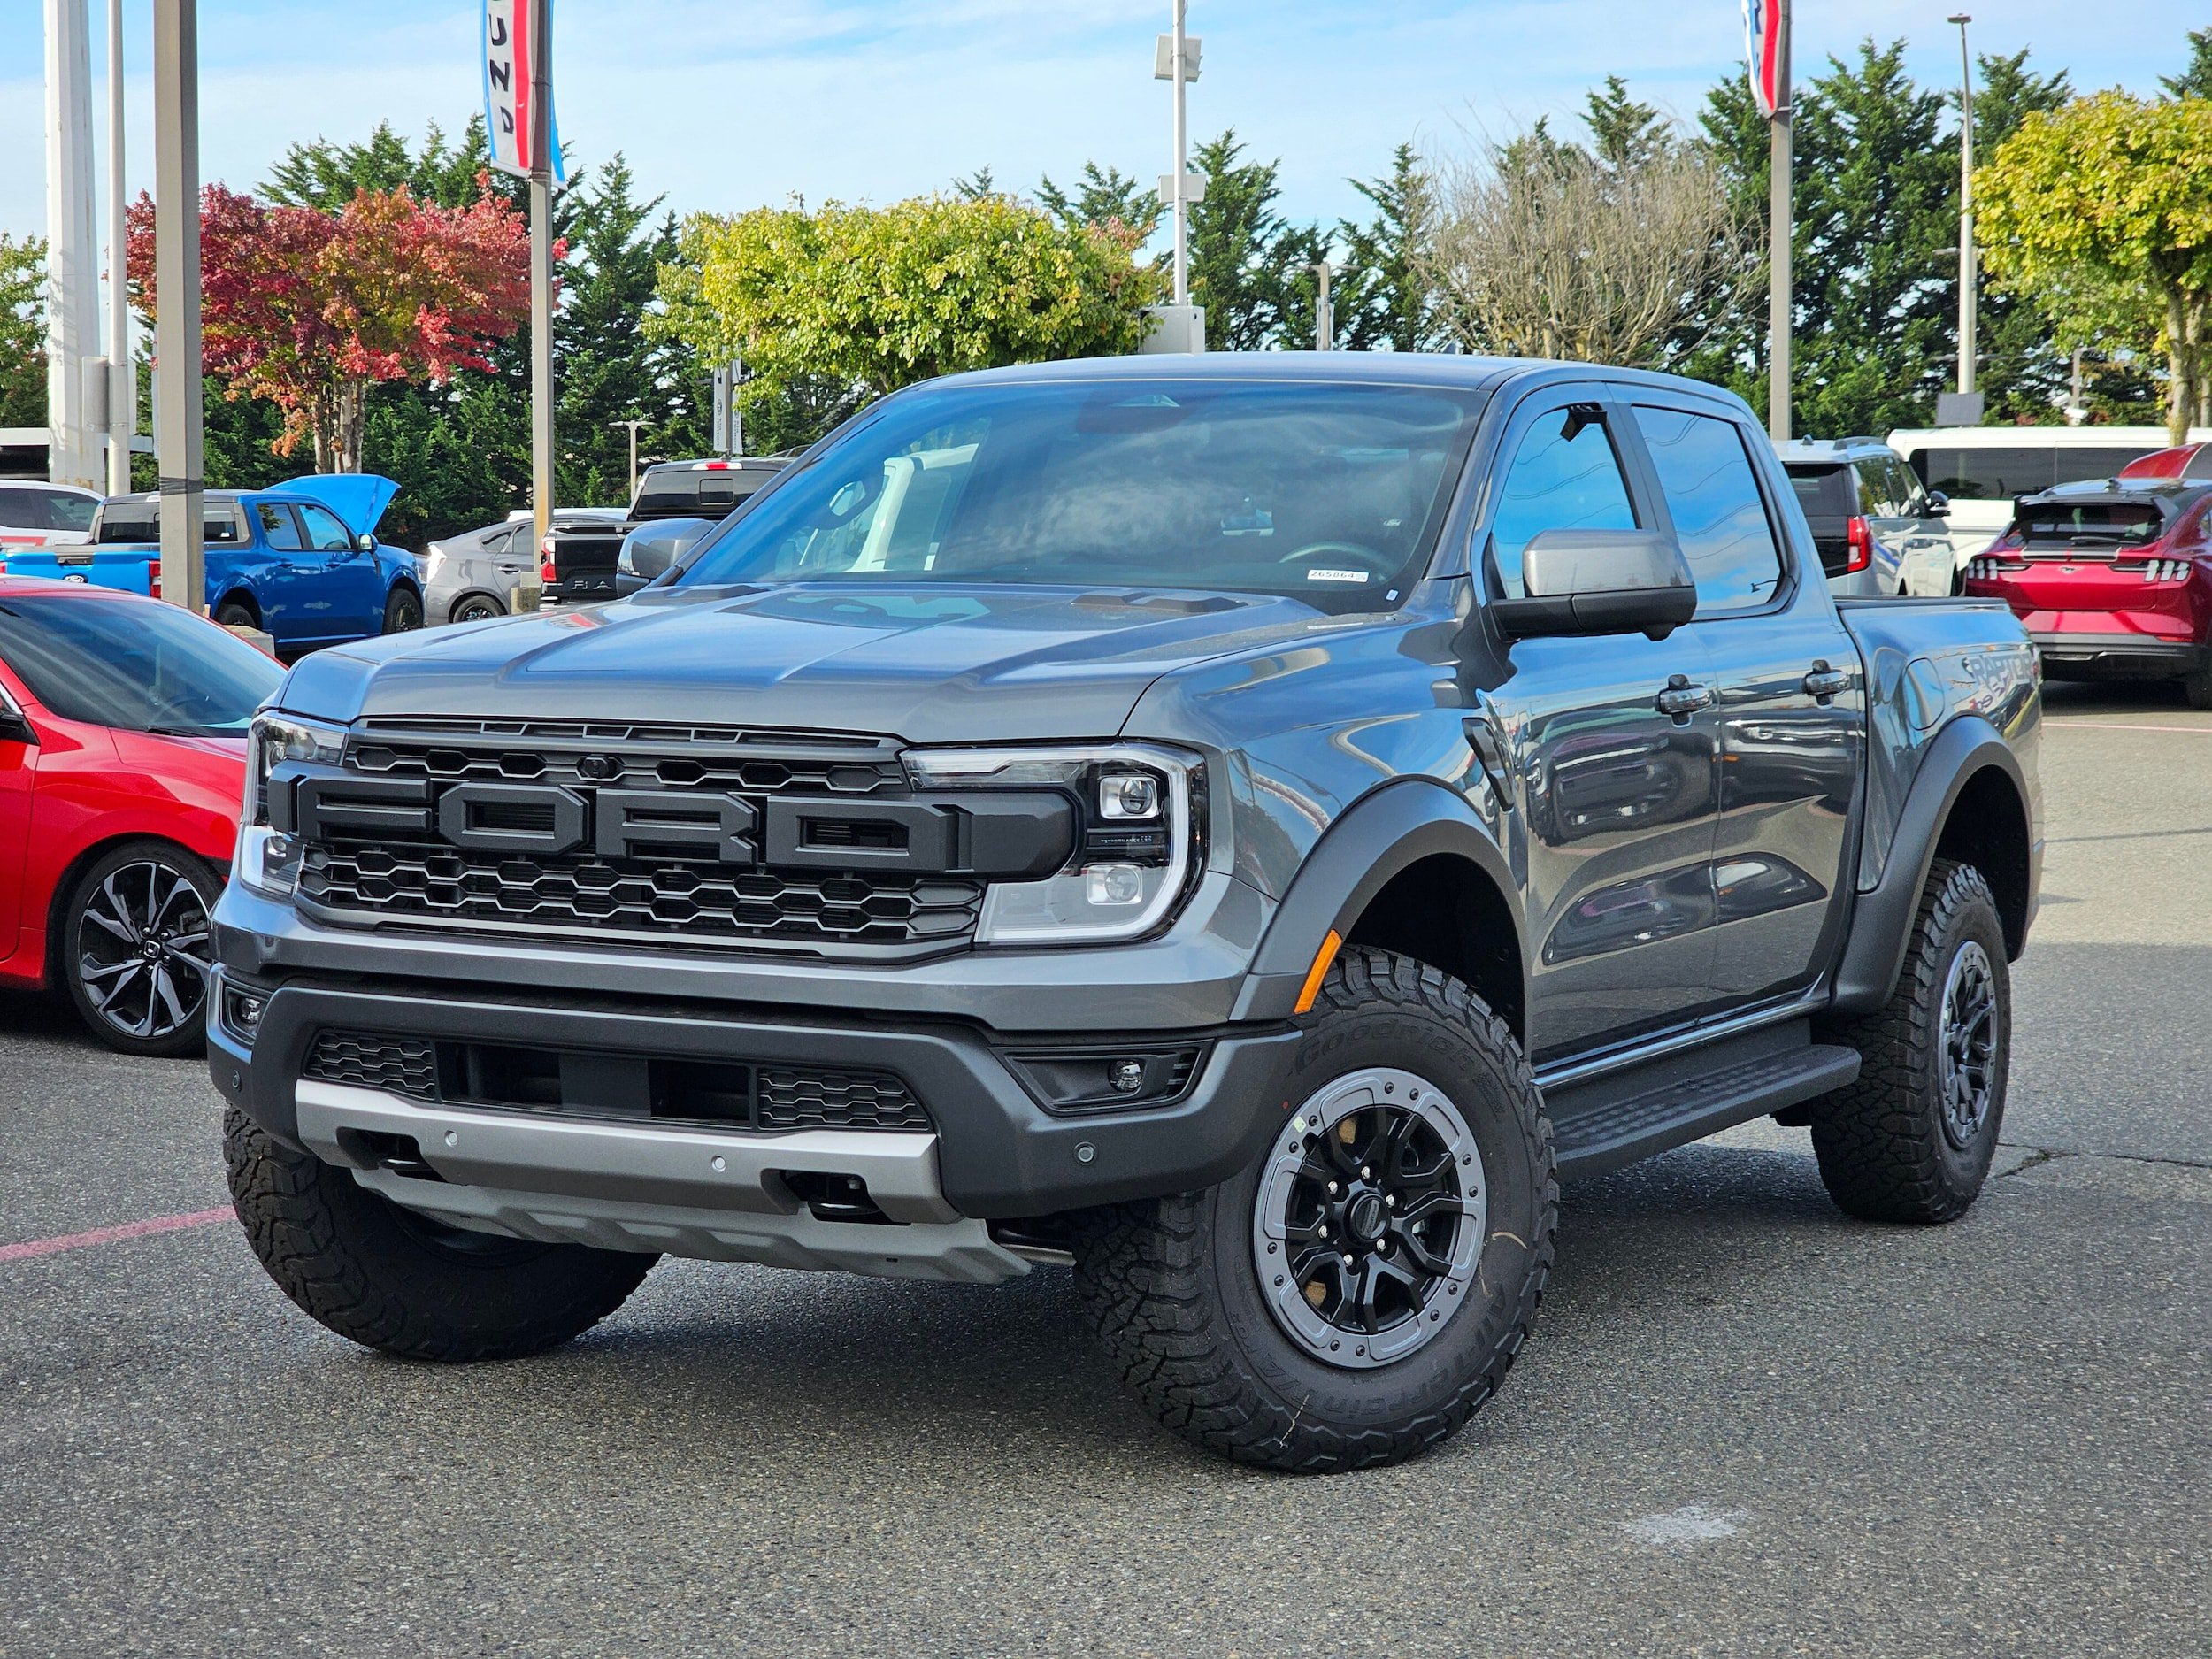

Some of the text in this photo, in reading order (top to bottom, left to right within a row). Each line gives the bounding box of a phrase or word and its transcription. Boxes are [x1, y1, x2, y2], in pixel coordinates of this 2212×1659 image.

[488, 0, 514, 134] UND
[571, 580, 613, 589] RA
[1970, 653, 2032, 692] RAPTOR
[297, 777, 954, 872] FORD
